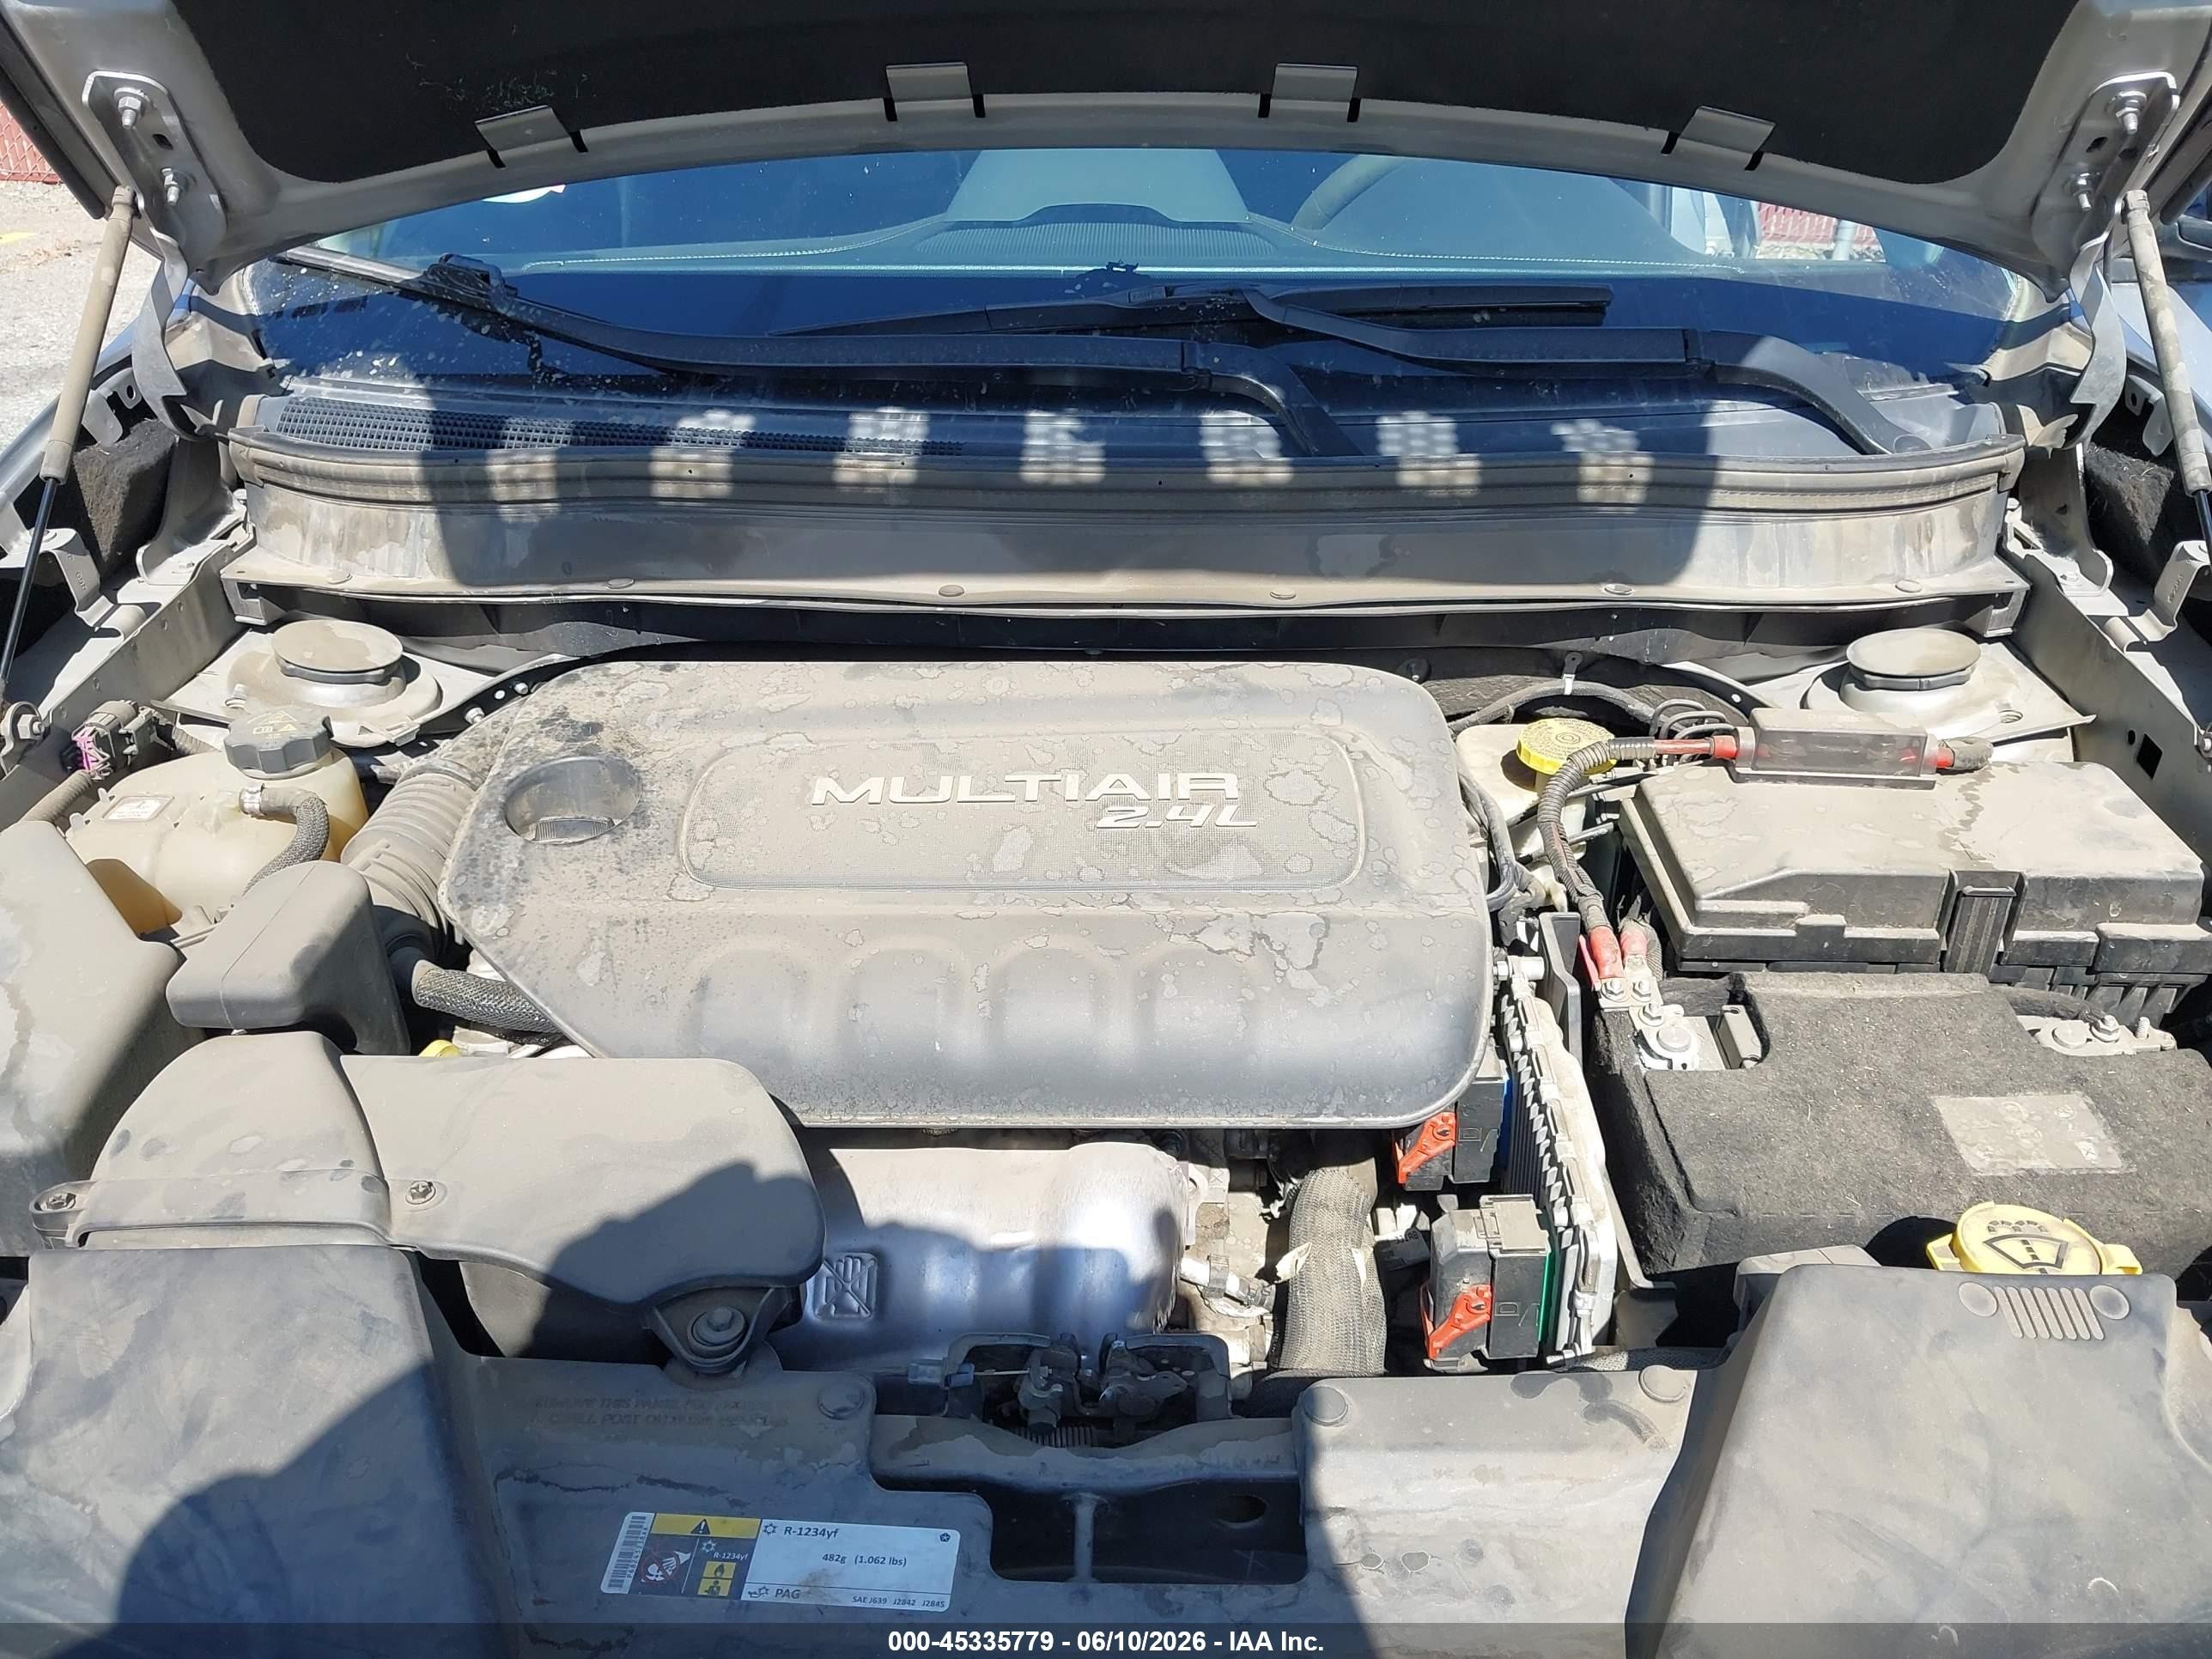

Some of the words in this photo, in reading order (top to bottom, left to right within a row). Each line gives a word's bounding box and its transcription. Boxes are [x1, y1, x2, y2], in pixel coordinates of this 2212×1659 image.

[811, 772, 1239, 805] MULTIAIR
[1096, 805, 1259, 830] 2.4L
[784, 1526, 839, 1540] R-1234yf
[714, 1552, 749, 1561] R-1234yf
[823, 1553, 847, 1566] 482g
[854, 1554, 885, 1567] (1.062
[888, 1555, 907, 1568] lbs)
[775, 1588, 800, 1601] PAG
[869, 1596, 888, 1605] J639
[921, 1600, 945, 1608] J2845
